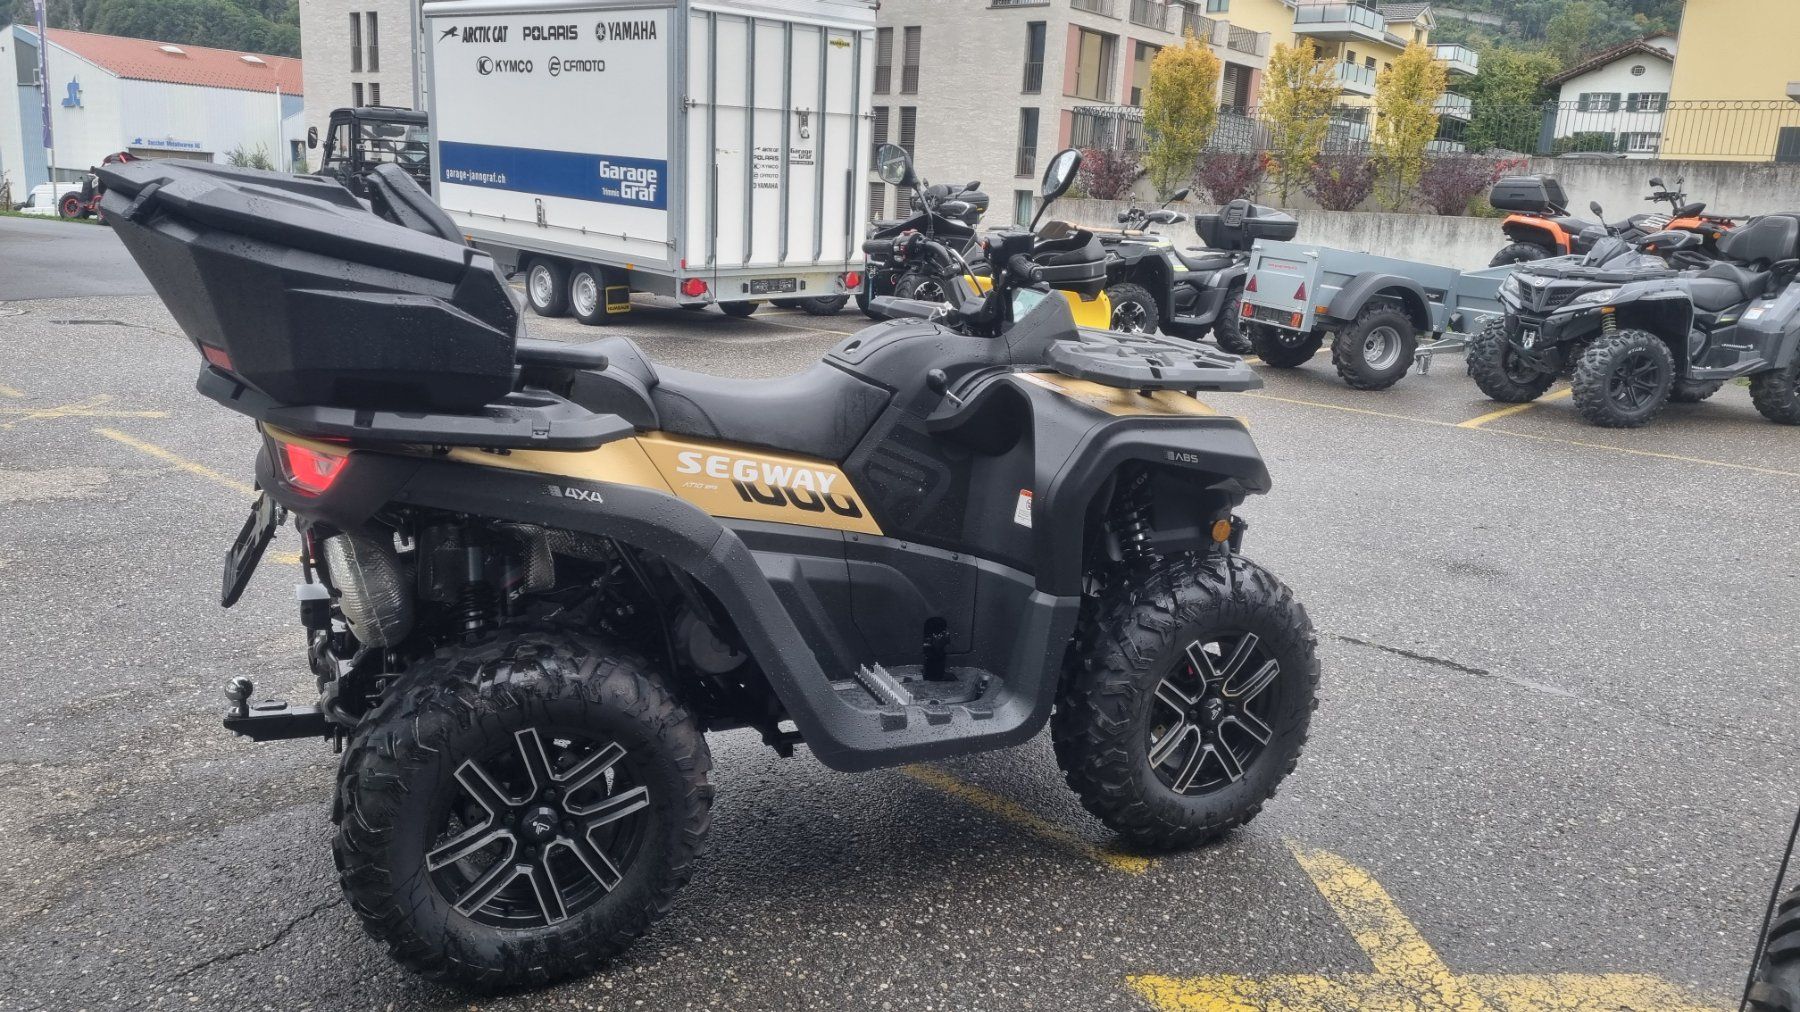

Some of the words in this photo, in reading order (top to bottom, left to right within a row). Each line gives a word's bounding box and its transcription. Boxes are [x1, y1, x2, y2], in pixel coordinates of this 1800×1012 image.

[462, 26, 490, 42] ARCTIC
[492, 26, 508, 42] CAT
[523, 25, 578, 41] POLARIS
[607, 20, 657, 41] YAMAHA
[495, 59, 533, 73] KYMCO
[563, 59, 605, 72] CFMOTO
[790, 148, 812, 156] Garage
[445, 168, 506, 184] garage-janngraf.ch
[600, 160, 657, 186] Garage
[620, 181, 657, 201] Graf
[1175, 452, 1199, 463] ABS
[676, 451, 837, 494] SEGWAY
